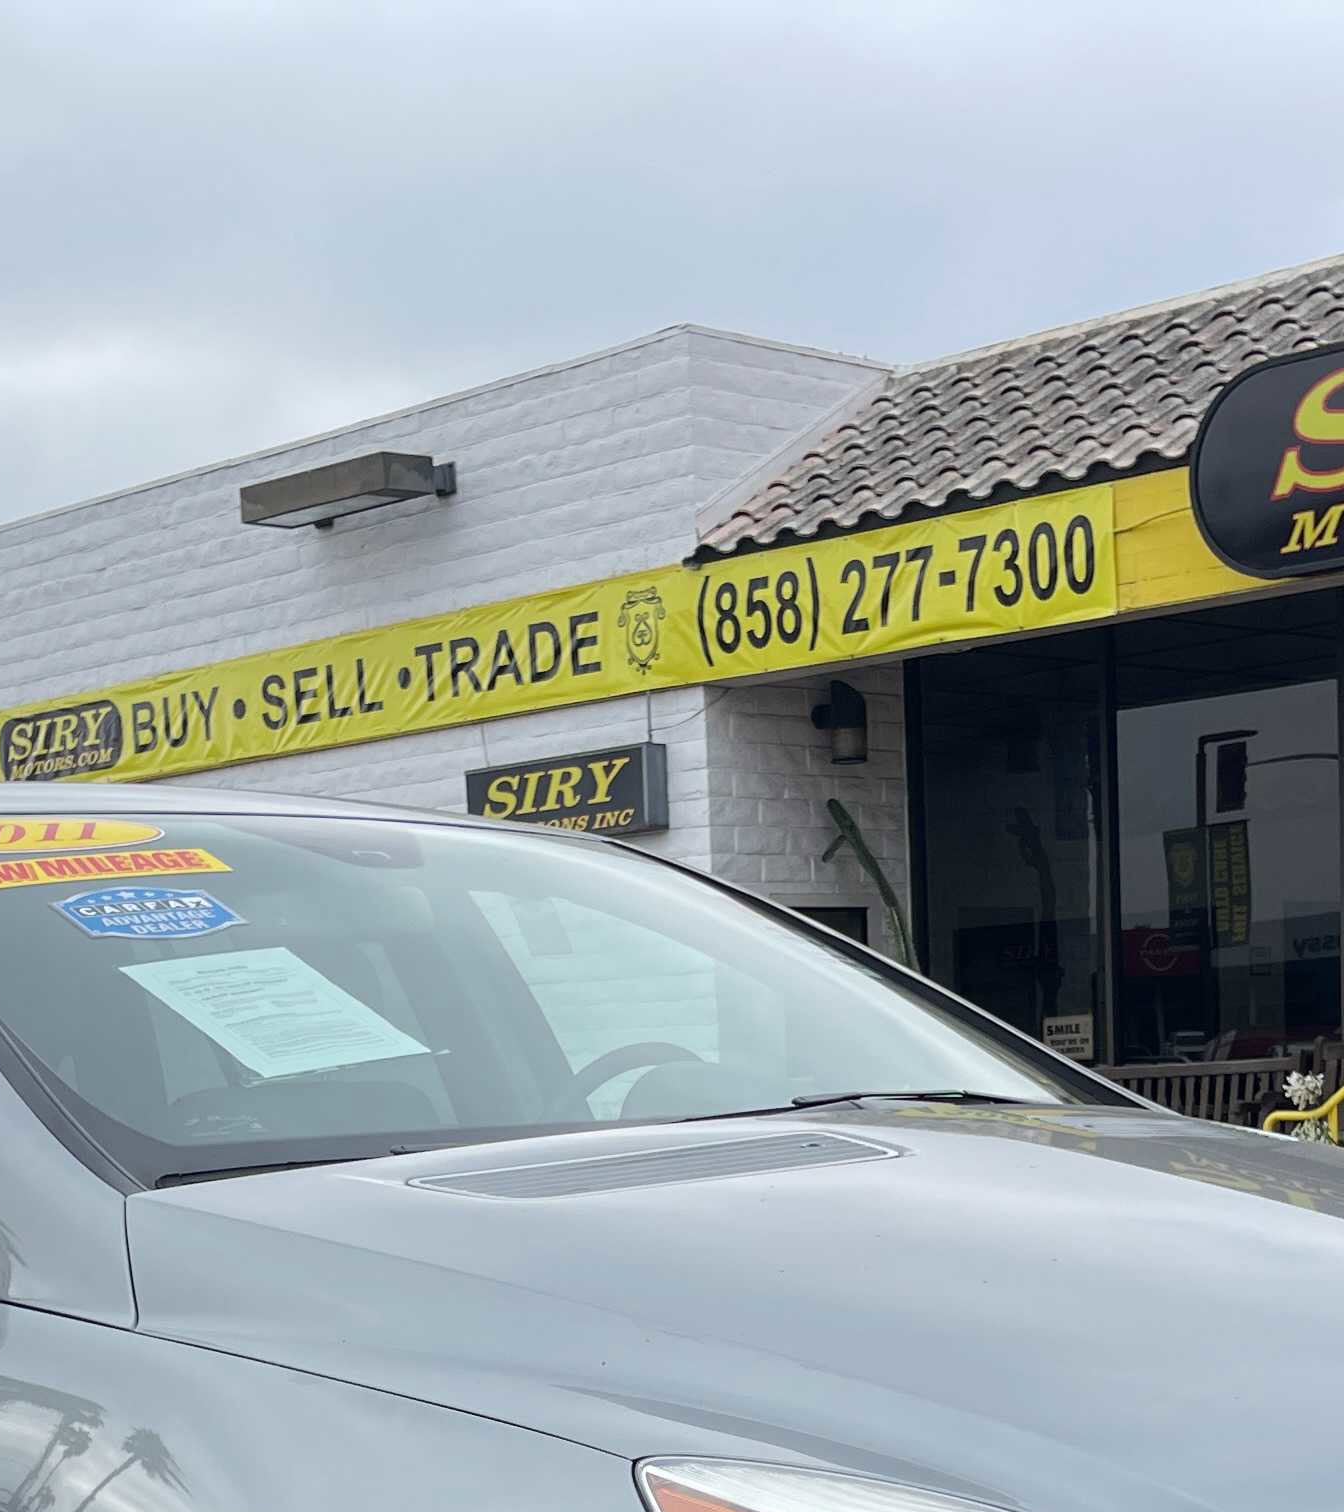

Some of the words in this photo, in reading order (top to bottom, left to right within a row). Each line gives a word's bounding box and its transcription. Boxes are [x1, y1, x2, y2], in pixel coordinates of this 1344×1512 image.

[697, 556, 821, 667] (858)
[841, 514, 1096, 635] 277-7300
[132, 686, 220, 755] BUY
[261, 657, 384, 732] SELL
[414, 611, 603, 702] TRADE
[7, 706, 112, 763] SIRY
[10, 748, 114, 781] MOTORS.COM
[482, 756, 631, 820] SIRY
[592, 808, 635, 830] INC
[34, 850, 209, 880] MILEAGE
[74, 896, 213, 918] CARFAX
[101, 909, 217, 928] ADVANTAGE
[132, 919, 210, 935] DEALER
[1046, 1023, 1081, 1037] SMILE
